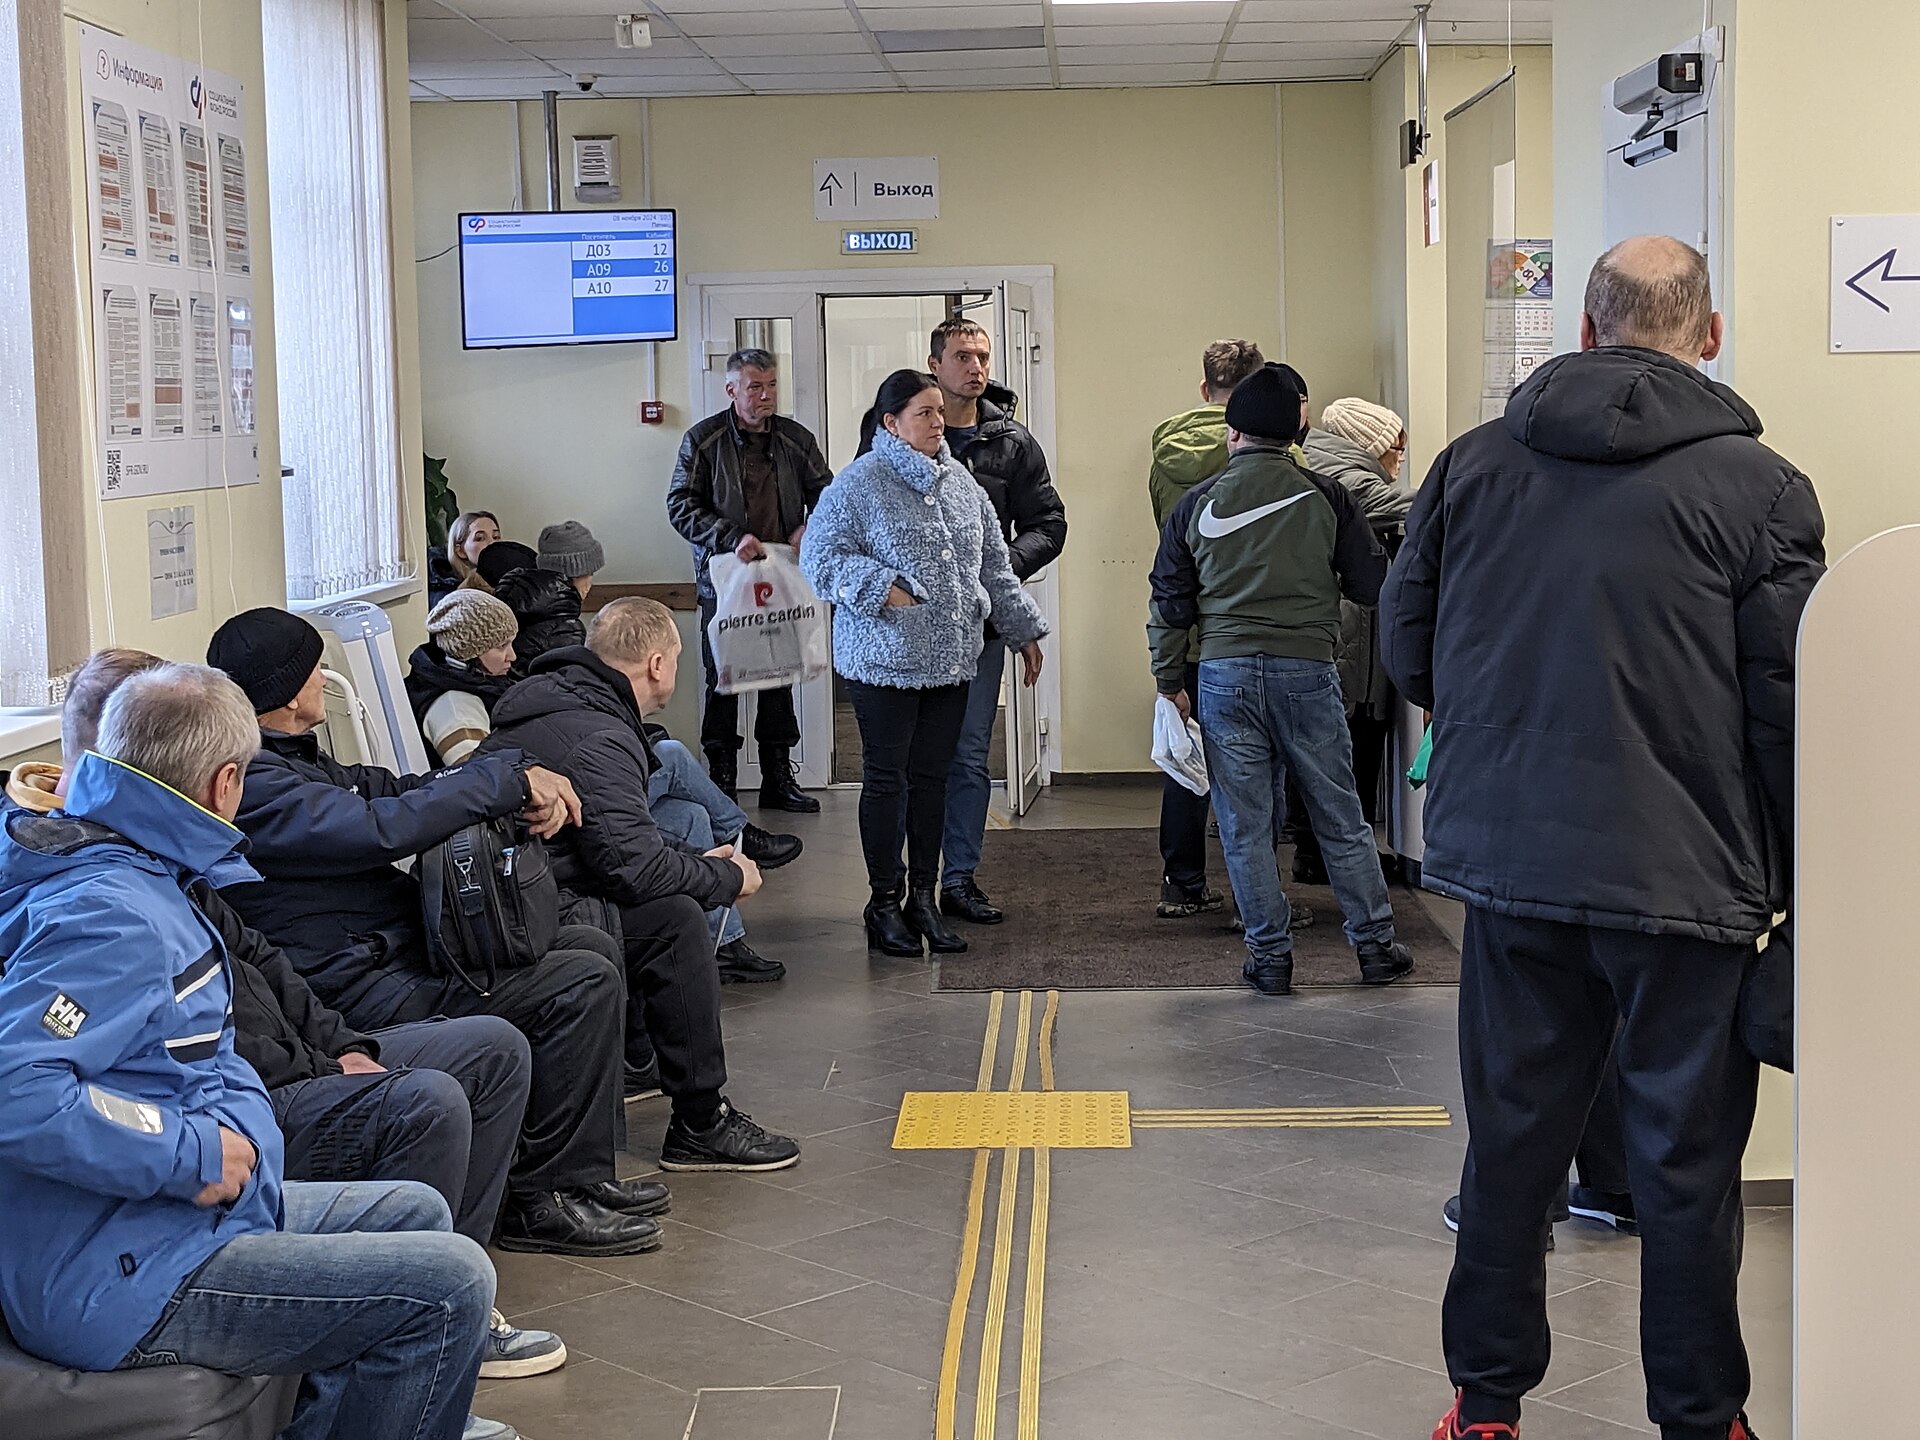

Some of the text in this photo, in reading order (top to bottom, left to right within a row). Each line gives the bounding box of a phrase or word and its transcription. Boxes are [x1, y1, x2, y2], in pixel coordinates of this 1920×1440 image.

[113, 58, 164, 93] Информация
[874, 183, 934, 198] Выход
[582, 233, 617, 241] Посетитель
[849, 233, 911, 249] ВЫХОД
[586, 243, 668, 258] Д03 12
[587, 261, 669, 276] А09 26
[588, 280, 669, 295] А10 27
[718, 613, 765, 635] pierre
[767, 602, 816, 625] cardin
[48, 994, 86, 1032] HH
